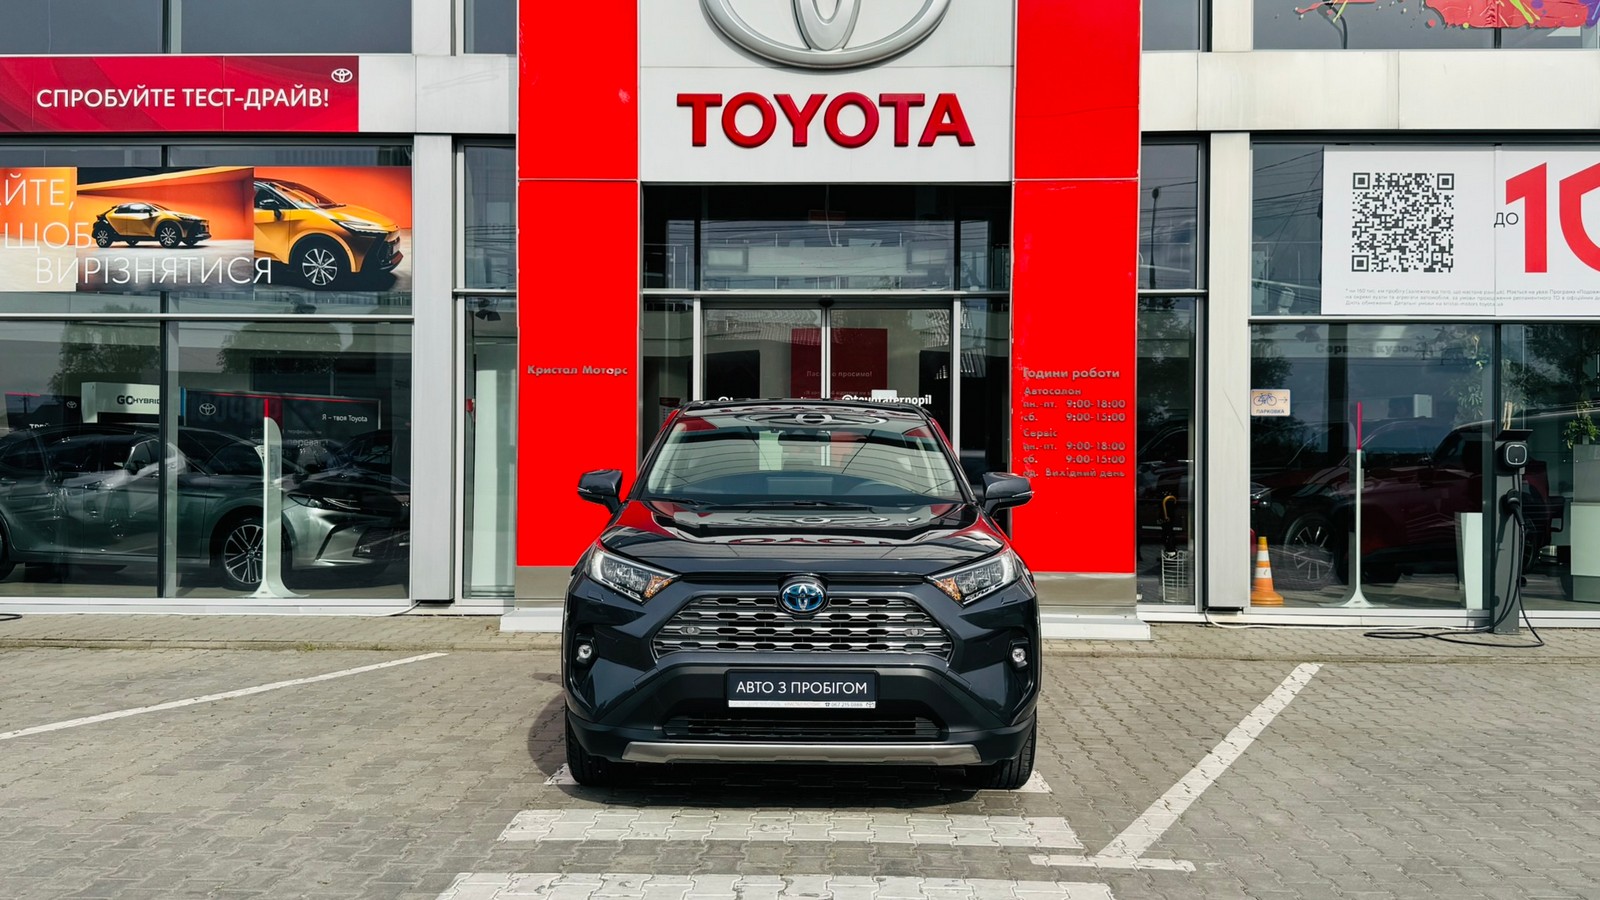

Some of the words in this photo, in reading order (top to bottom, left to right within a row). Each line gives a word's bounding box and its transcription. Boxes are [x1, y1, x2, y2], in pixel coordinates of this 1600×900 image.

[36, 84, 175, 108] СПРОБУЙТЕ
[182, 84, 329, 111] ТЕСТ-ДРАЙВ!
[676, 92, 976, 148] TOYOTA
[0, 173, 74, 210] ЙТЕ,
[1494, 212, 1519, 228] ДО
[4, 222, 92, 254] ЩОБ
[36, 257, 272, 284] ВИРІЗНЯТИСЯ
[528, 365, 578, 376] Кристал
[582, 365, 628, 376] Моторс
[1023, 367, 1068, 379] Години
[1072, 367, 1120, 380] роботи
[1024, 387, 1081, 396] Автосалон
[1023, 428, 1057, 439] Сервіс
[736, 681, 774, 693] АВТО
[791, 682, 867, 694] ПРОБІГОМ
